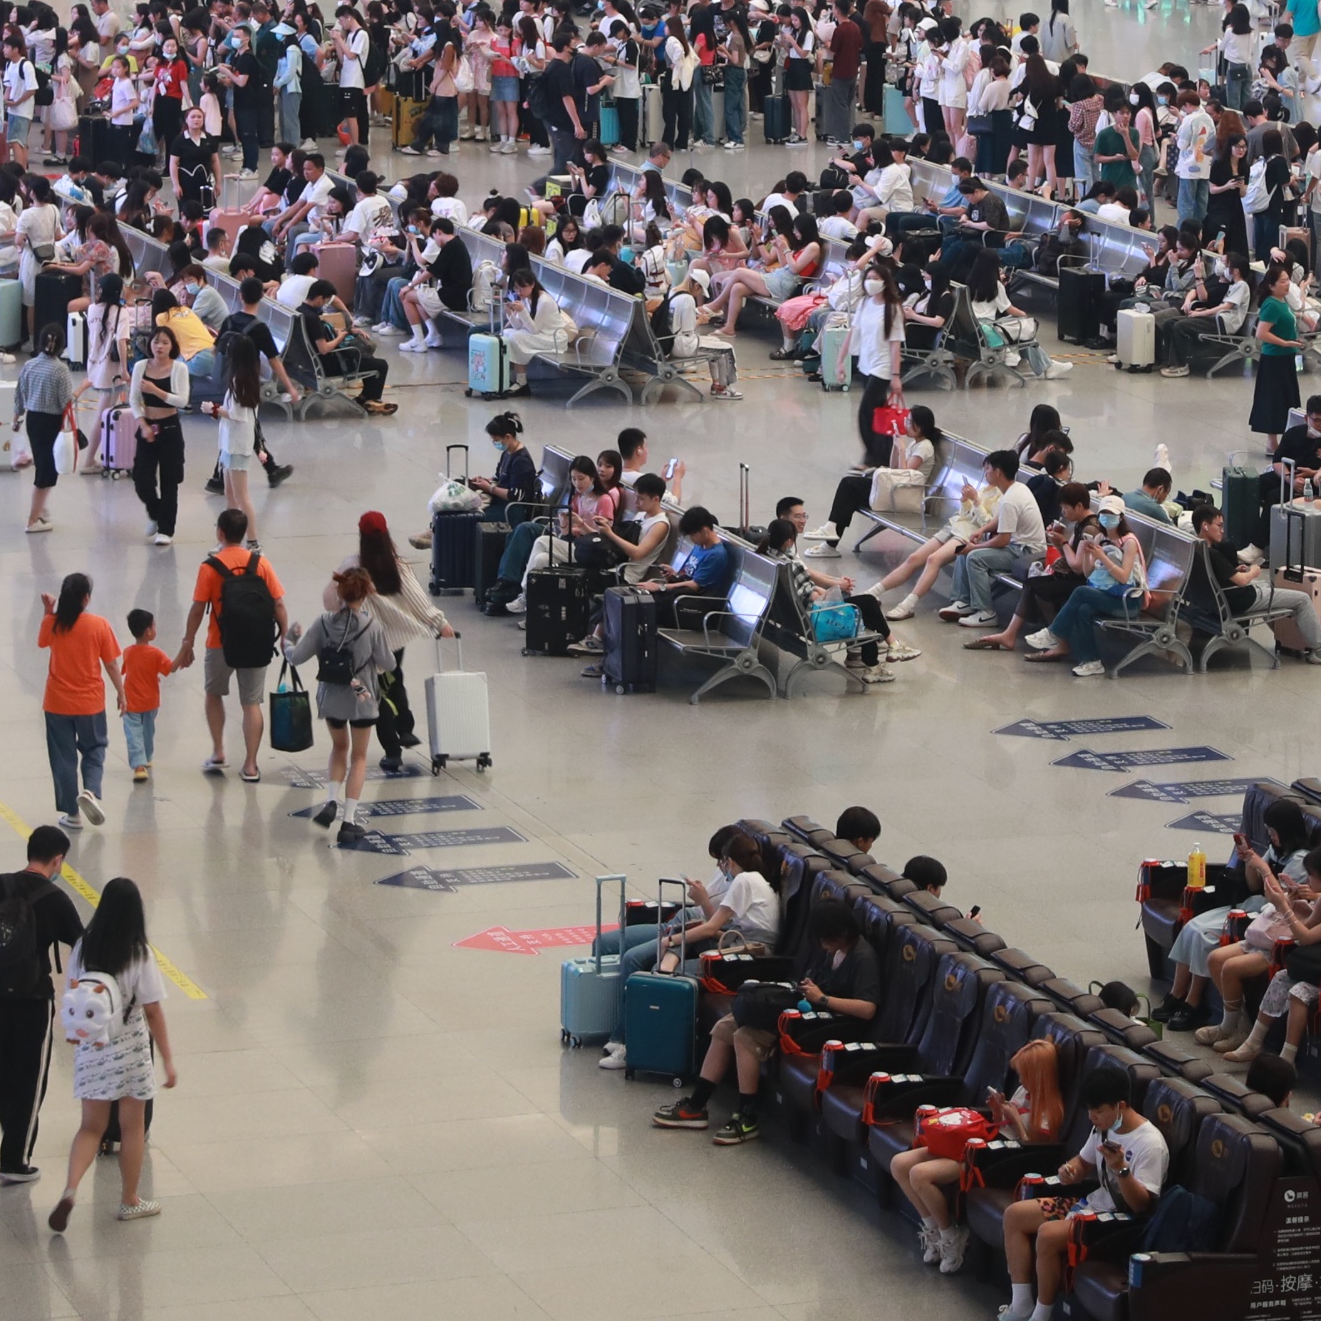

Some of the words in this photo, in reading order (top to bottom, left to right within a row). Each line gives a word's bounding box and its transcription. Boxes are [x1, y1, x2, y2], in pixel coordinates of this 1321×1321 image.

[1250, 1299, 1287, 1309] 用户服务声明
